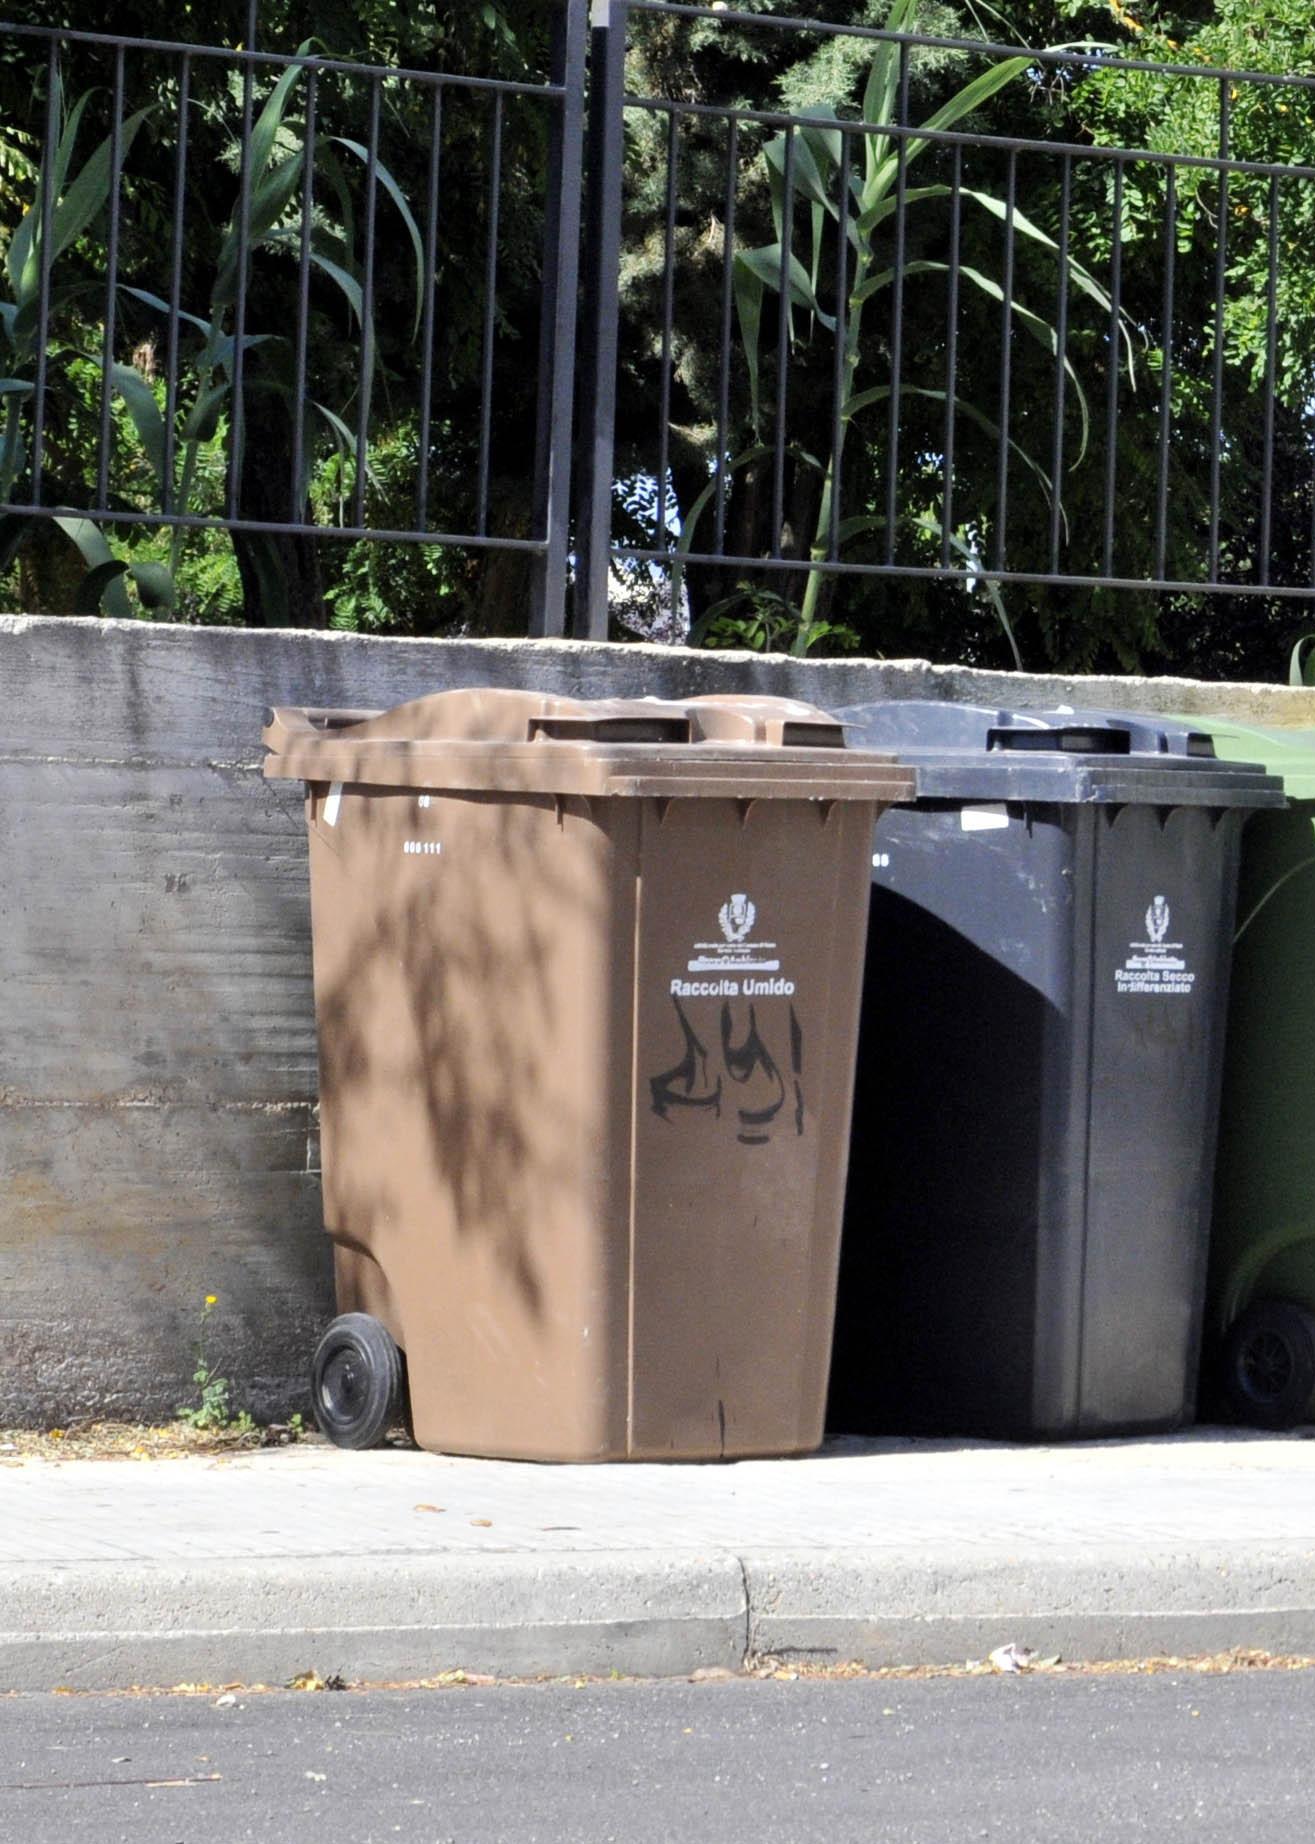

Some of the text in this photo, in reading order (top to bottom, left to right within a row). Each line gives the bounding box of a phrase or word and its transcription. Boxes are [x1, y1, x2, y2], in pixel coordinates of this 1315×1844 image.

[1115, 969, 1195, 982] Raccolta Secco
[670, 978, 795, 996] Raccolta Umido
